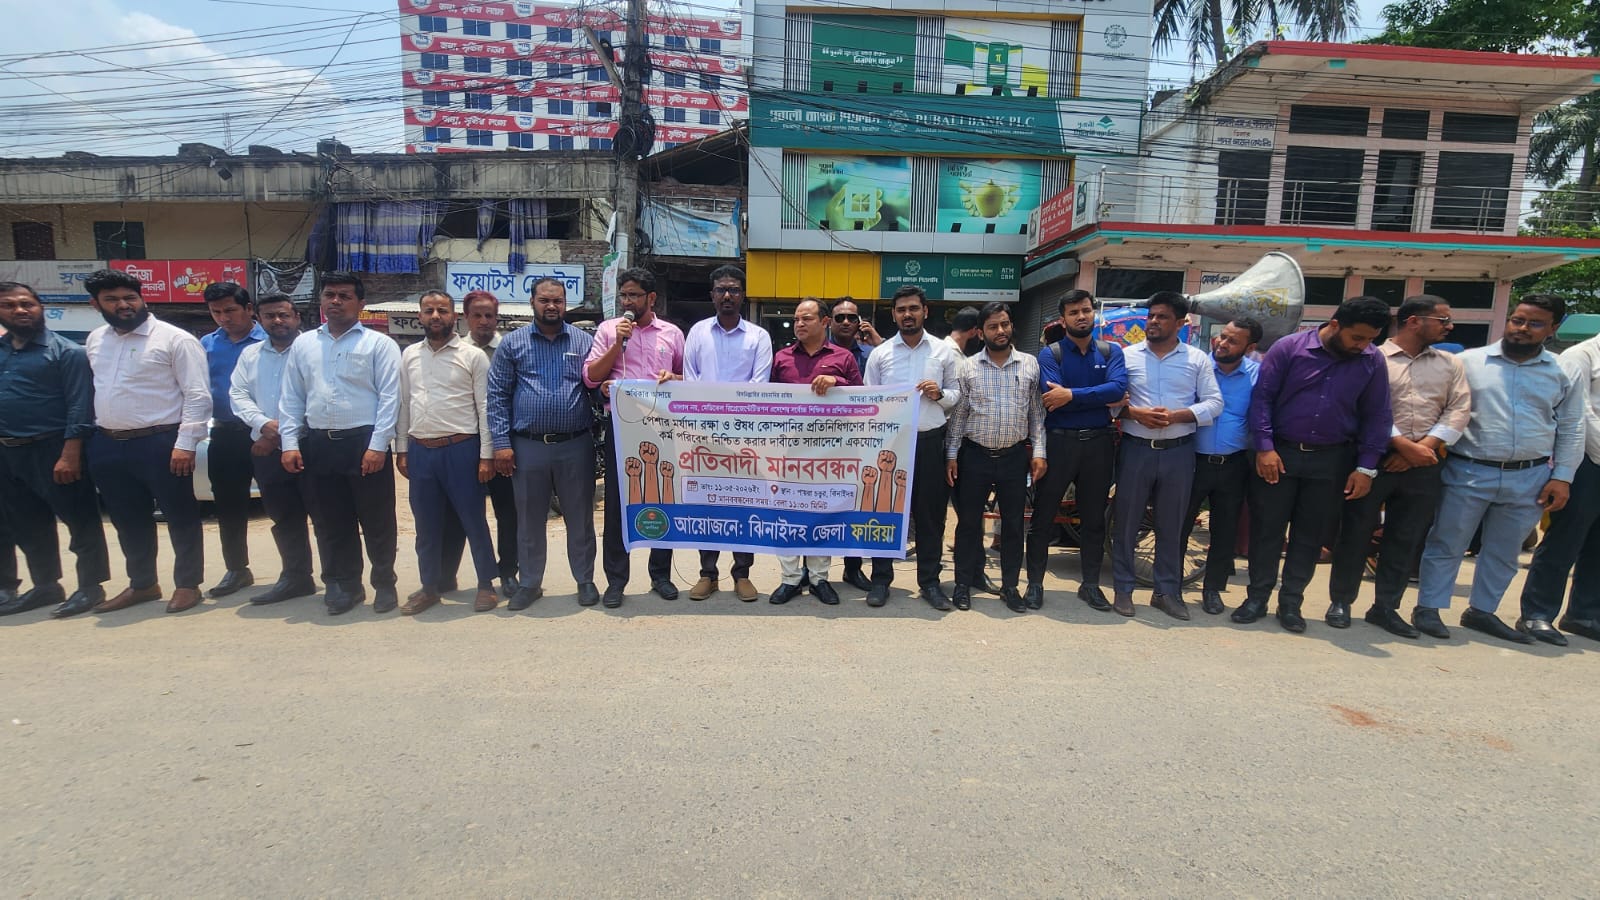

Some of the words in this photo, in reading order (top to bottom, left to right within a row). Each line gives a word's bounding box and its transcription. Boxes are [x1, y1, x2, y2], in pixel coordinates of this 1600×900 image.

[642, 416, 670, 427] পেশার
[672, 416, 697, 431] মর্যাদা
[700, 419, 719, 431] রক্ষা
[722, 420, 730, 431] ও
[733, 418, 755, 432] ঔষধ
[757, 418, 804, 433] কোম্পানির
[806, 418, 865, 433] প্রতিনিধিগণের
[868, 418, 901, 433] নিরাপদ
[659, 428, 673, 441] কর্ম
[675, 430, 709, 445] পরিবেশ
[711, 432, 741, 447] নিশ্চিত
[743, 436, 766, 447] করার
[769, 433, 800, 448] দাবীতে
[802, 436, 844, 449] সারাদেশে
[846, 437, 884, 449] একযোগে
[678, 445, 761, 476] প্রতিবাদী
[765, 455, 863, 481] মানববন্ধন
[810, 500, 828, 510] মিনিট
[673, 516, 743, 538] আয়োজনে:
[748, 514, 808, 543] ঝিনাইদহ
[812, 521, 848, 542] জেলা
[850, 519, 896, 543] ফারিয়া
